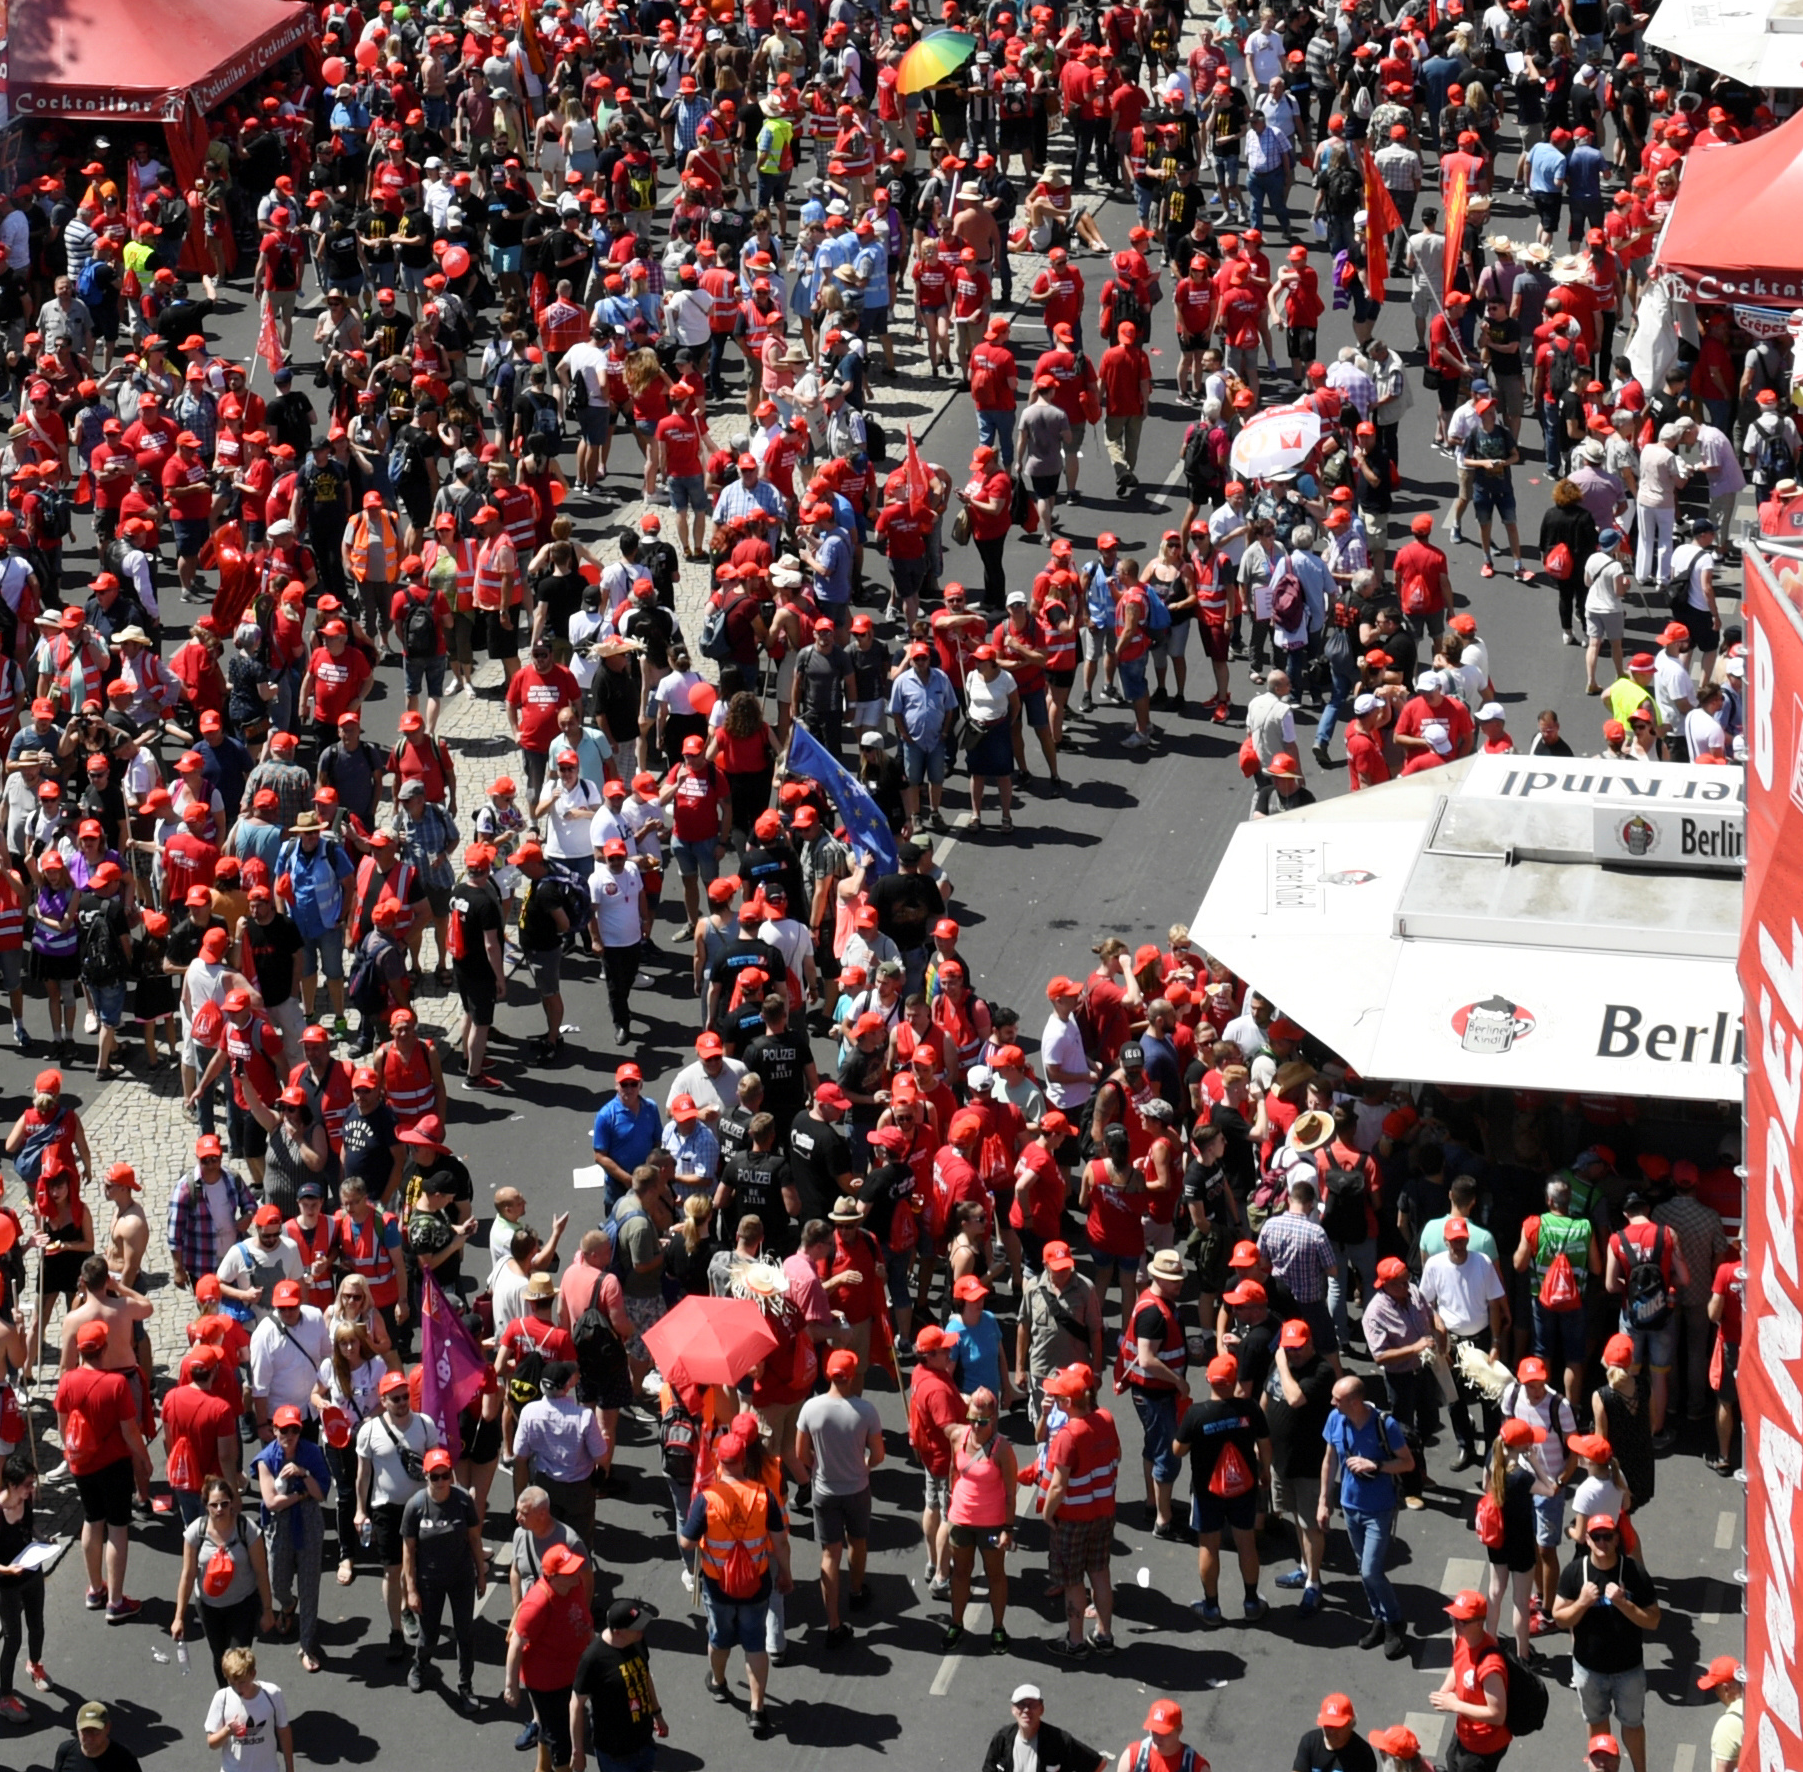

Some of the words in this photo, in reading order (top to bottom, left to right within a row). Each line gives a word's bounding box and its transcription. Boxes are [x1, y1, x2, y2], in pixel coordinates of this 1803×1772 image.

[15, 92, 152, 115] Cocktailbar
[1739, 311, 1788, 335] Crêpes
[1753, 614, 1774, 792] B
[762, 1048, 797, 1062] POLIZEI
[737, 1168, 771, 1185] POLIZEI
